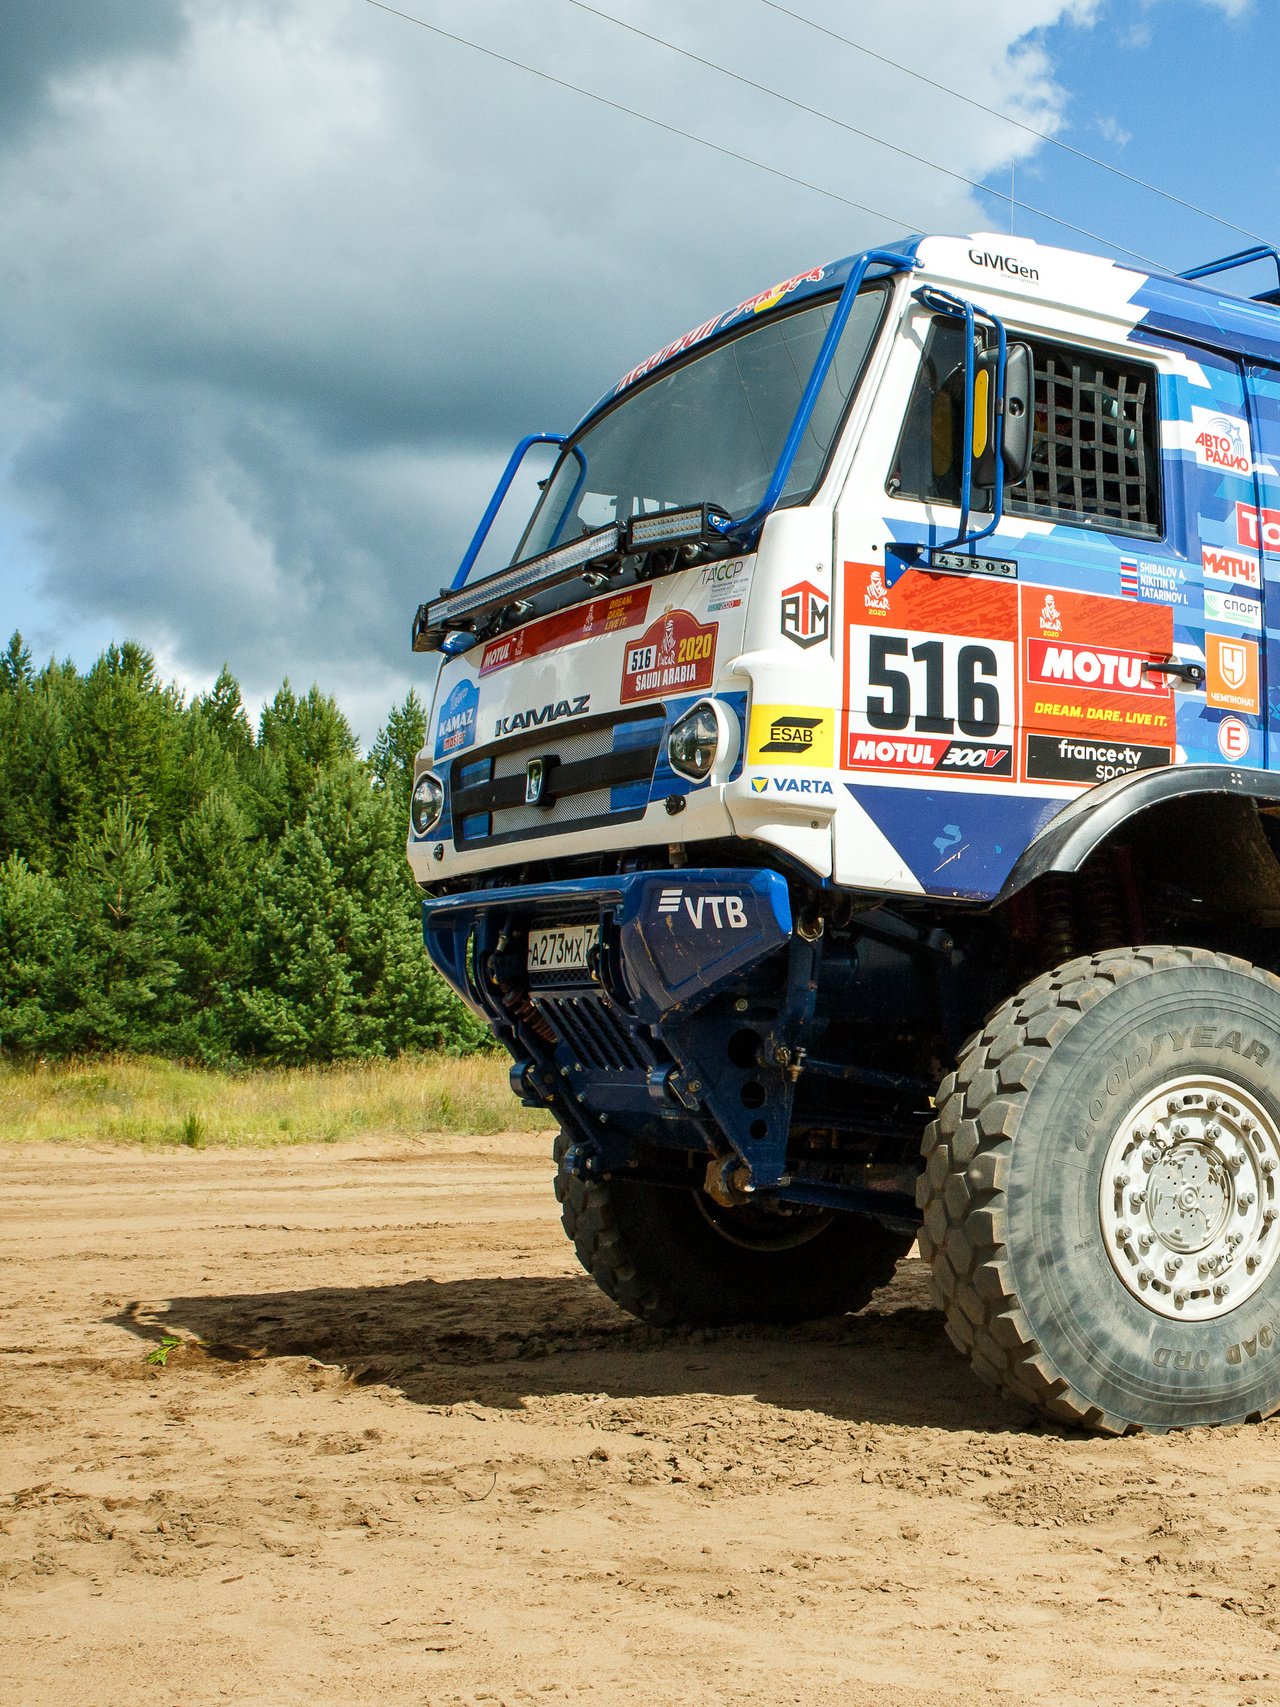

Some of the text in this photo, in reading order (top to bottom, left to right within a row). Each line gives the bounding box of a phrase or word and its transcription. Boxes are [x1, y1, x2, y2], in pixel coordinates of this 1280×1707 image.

[968, 249, 1039, 281] GMGen
[938, 555, 1011, 574] 43509
[1140, 562, 1187, 580] SHIBALOV A.
[1140, 574, 1178, 591] NIKITIN D.
[1140, 586, 1182, 604] TATARINOV
[868, 608, 887, 617] 2020
[1223, 599, 1259, 616] СПОРТ
[1043, 630, 1060, 638] 2020
[483, 642, 511, 669] MOTUL
[631, 633, 713, 672] 516 2020
[636, 663, 697, 692] SAUDI ARABIA
[867, 634, 1000, 738] 516
[1211, 692, 1255, 708] ЧЕМПИОНАТ
[439, 707, 474, 738] KAMAZ
[495, 694, 591, 737] KAMAZ
[1034, 702, 1168, 727] DREAM. DARE. LIVE IT.
[770, 727, 813, 743] ESAB
[853, 740, 1009, 769] MOTUL 300V
[773, 778, 834, 795] VARTA
[684, 895, 748, 929] VTB
[1075, 1024, 1271, 1151] GOODYEAR
